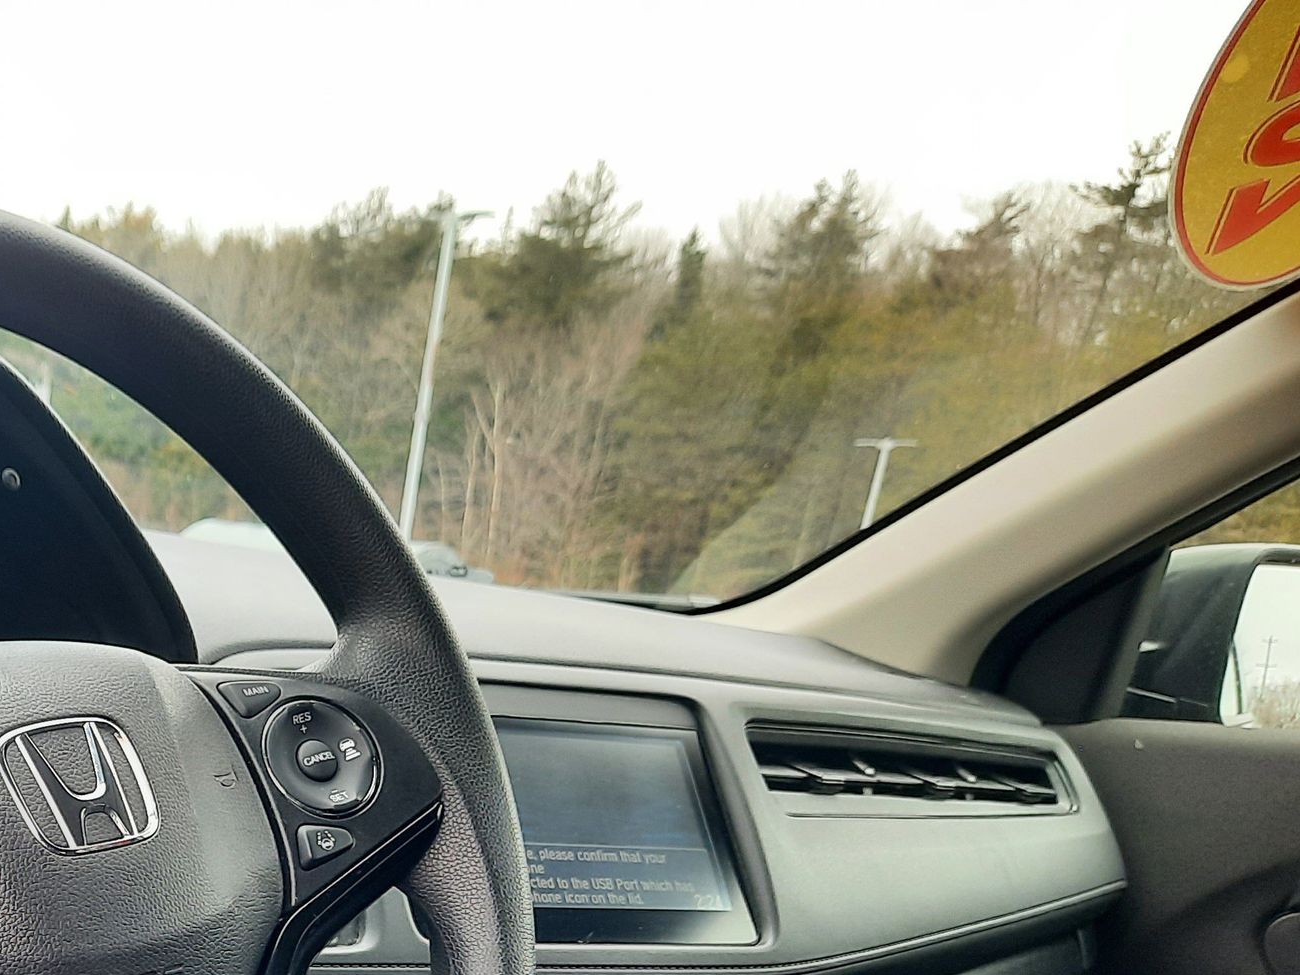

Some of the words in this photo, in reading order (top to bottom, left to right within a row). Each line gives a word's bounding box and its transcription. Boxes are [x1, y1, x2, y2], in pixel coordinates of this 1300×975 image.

[242, 686, 270, 697] MAIN
[292, 711, 312, 725] RES
[303, 751, 336, 767] CANCEL
[329, 791, 349, 803] SET
[539, 849, 575, 861] please
[577, 850, 617, 862] confirm
[619, 851, 642, 863] that
[643, 854, 667, 865] your
[557, 877, 569, 889] to
[571, 877, 589, 890] the
[591, 878, 613, 891] USB
[615, 878, 639, 891] Port
[564, 891, 589, 904] icon
[591, 894, 606, 905] on
[607, 893, 627, 905] the
[628, 893, 644, 905] lid.
